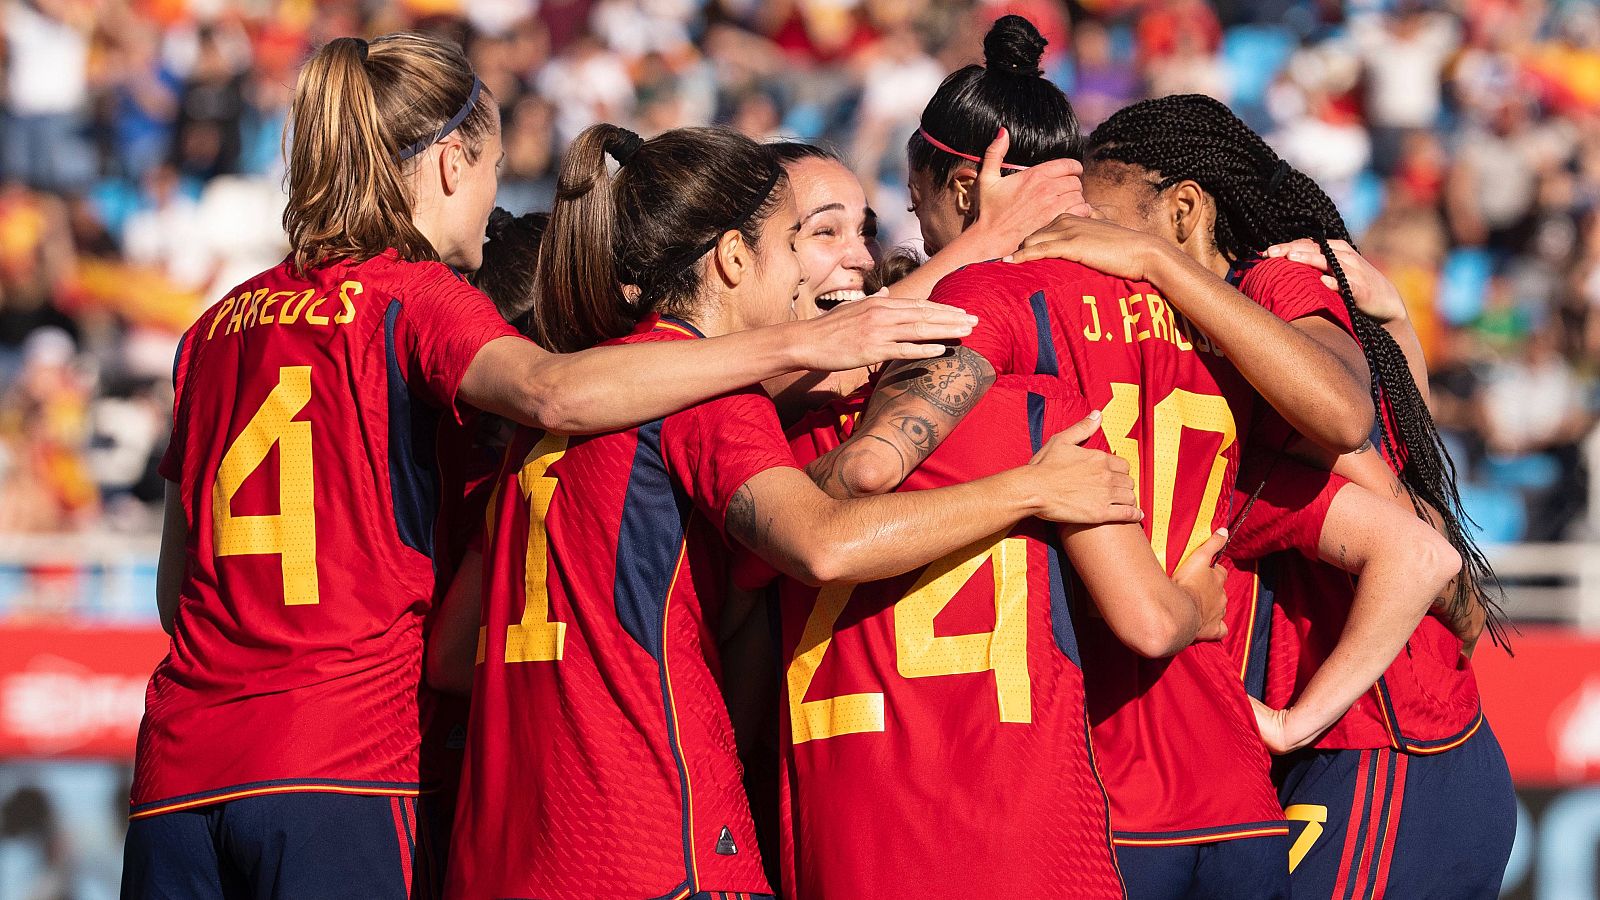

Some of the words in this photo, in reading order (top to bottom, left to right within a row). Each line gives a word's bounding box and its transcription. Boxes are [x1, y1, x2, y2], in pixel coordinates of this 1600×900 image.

[207, 281, 363, 340] PAREDES
[1083, 296, 1113, 341] J.
[212, 365, 320, 606] 4
[475, 433, 567, 666] 1
[1100, 382, 1237, 575] 10
[787, 525, 1031, 744] 24
[1284, 804, 1328, 875] 7
